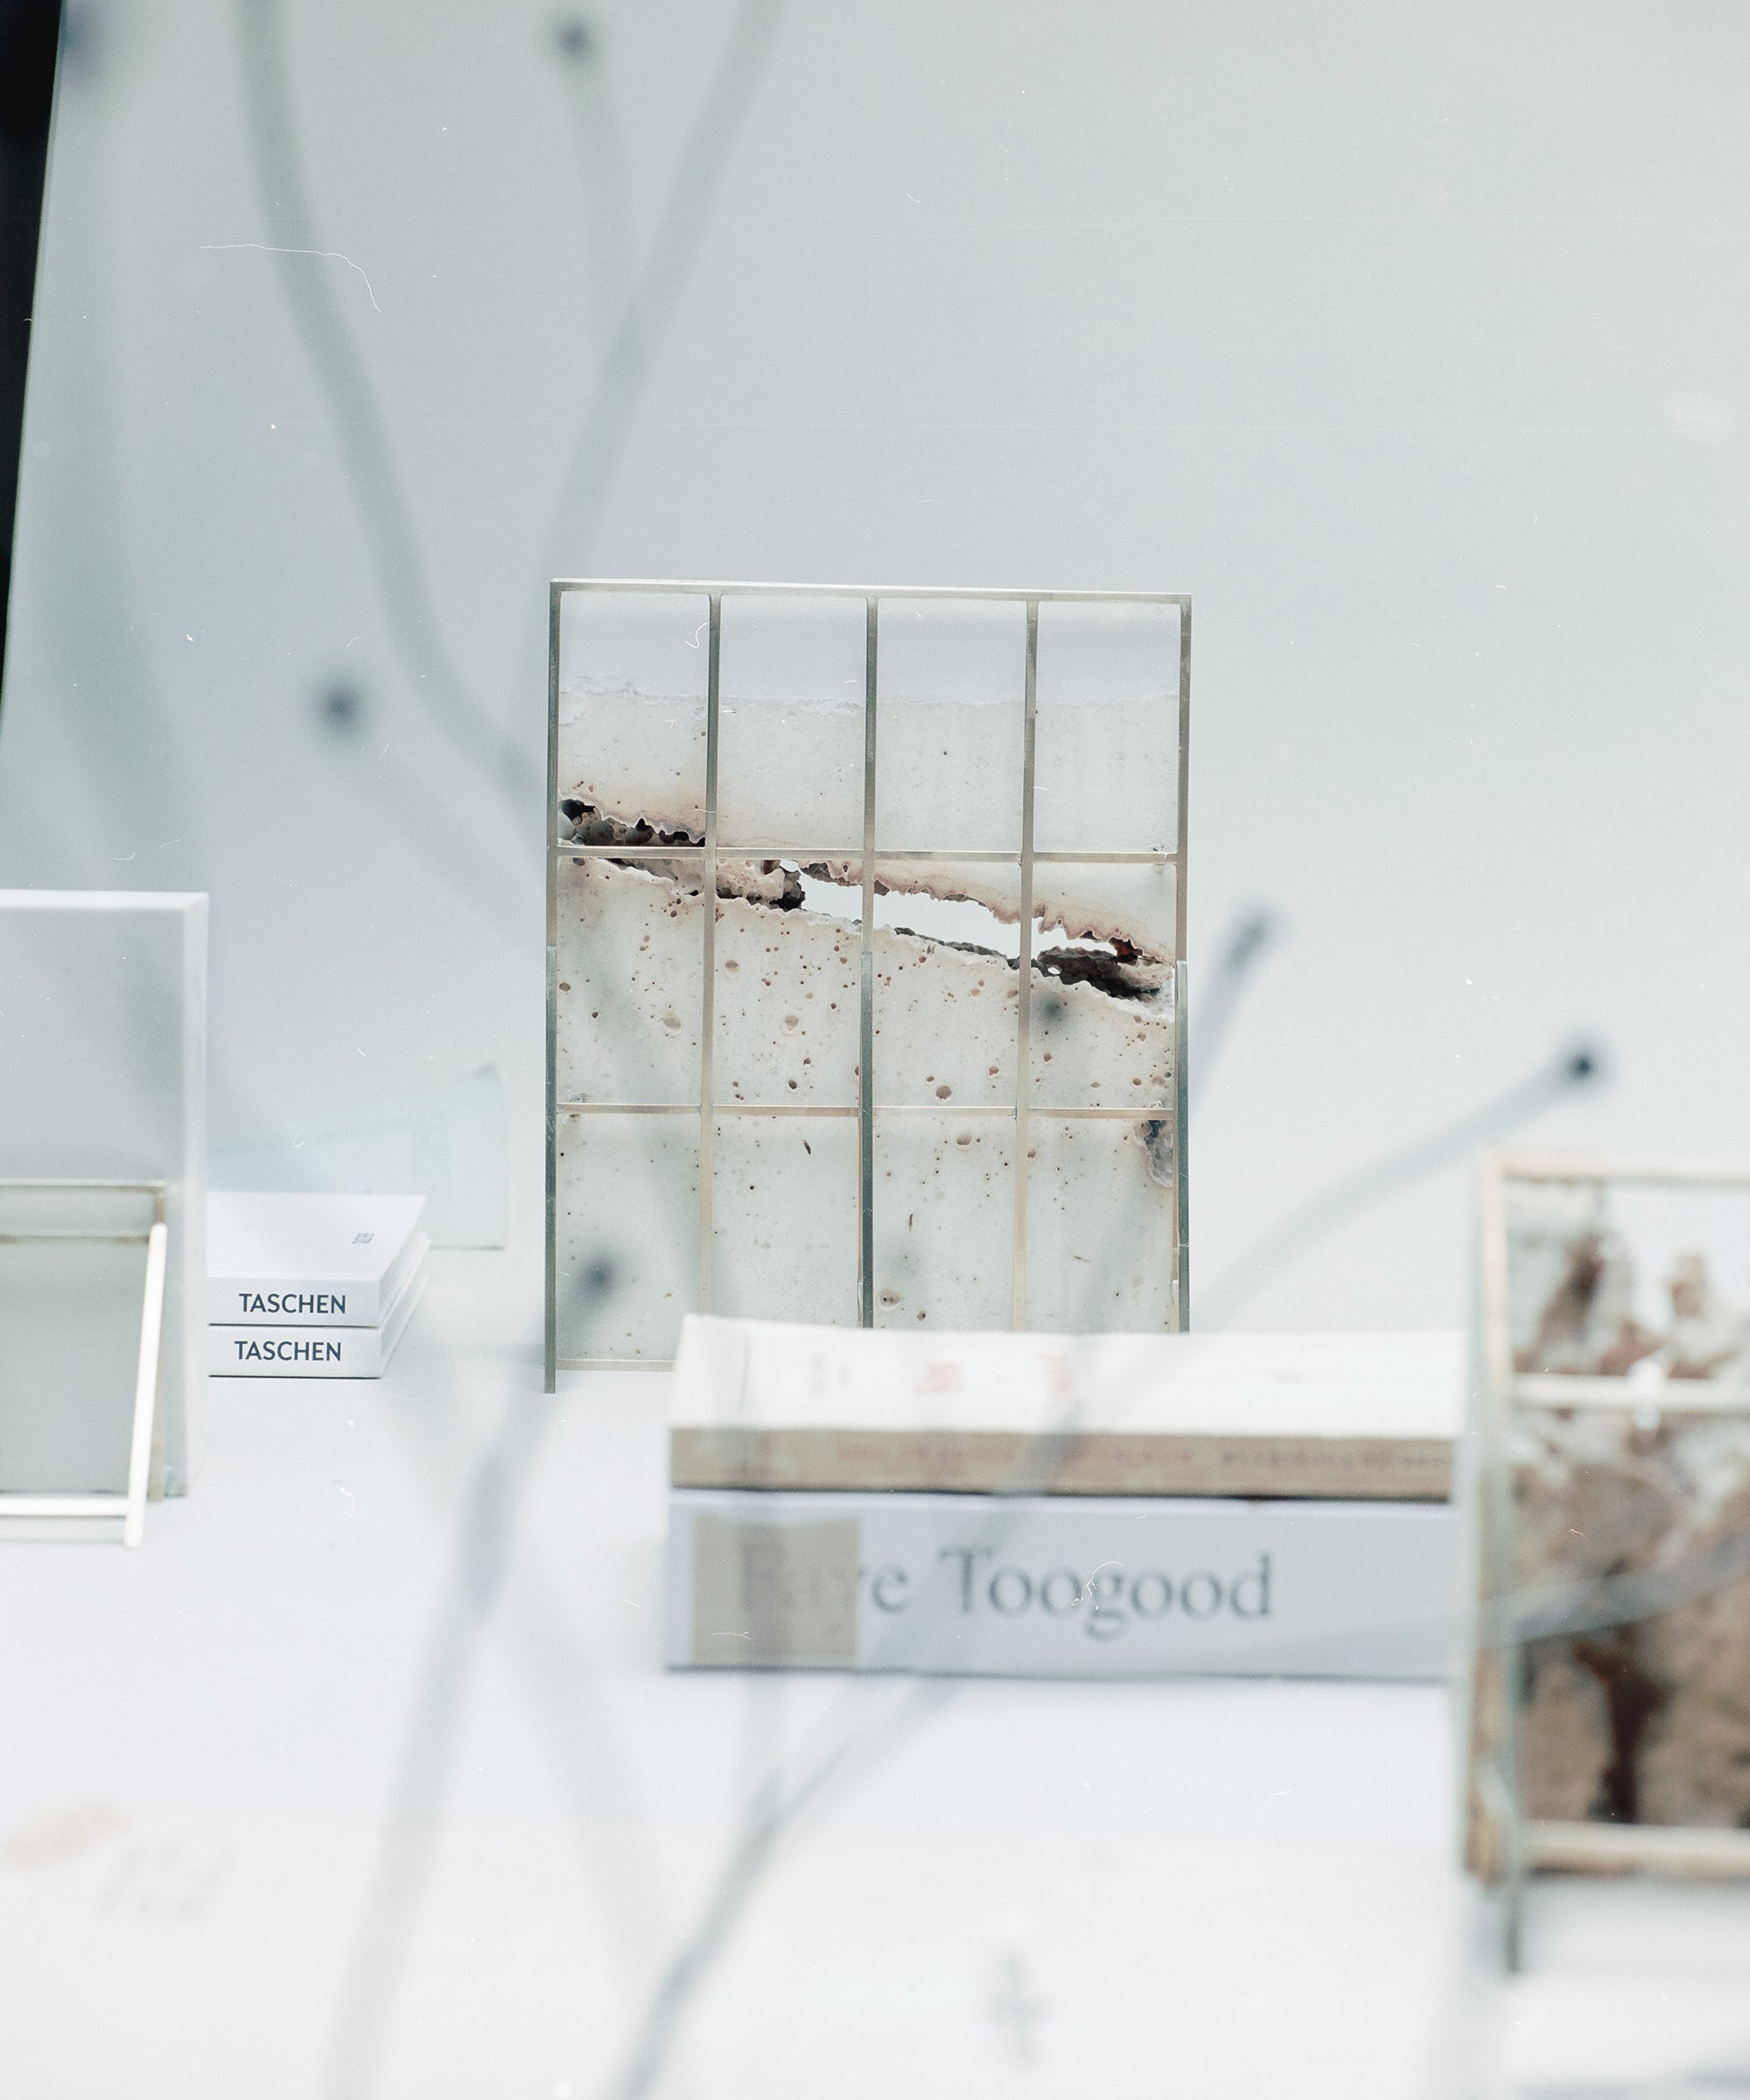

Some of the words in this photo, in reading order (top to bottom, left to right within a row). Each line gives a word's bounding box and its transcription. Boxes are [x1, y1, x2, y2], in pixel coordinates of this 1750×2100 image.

[238, 1292, 346, 1314] TASCHEN
[234, 1340, 341, 1362] TASCHEN
[936, 1544, 1272, 1642] Toogood
